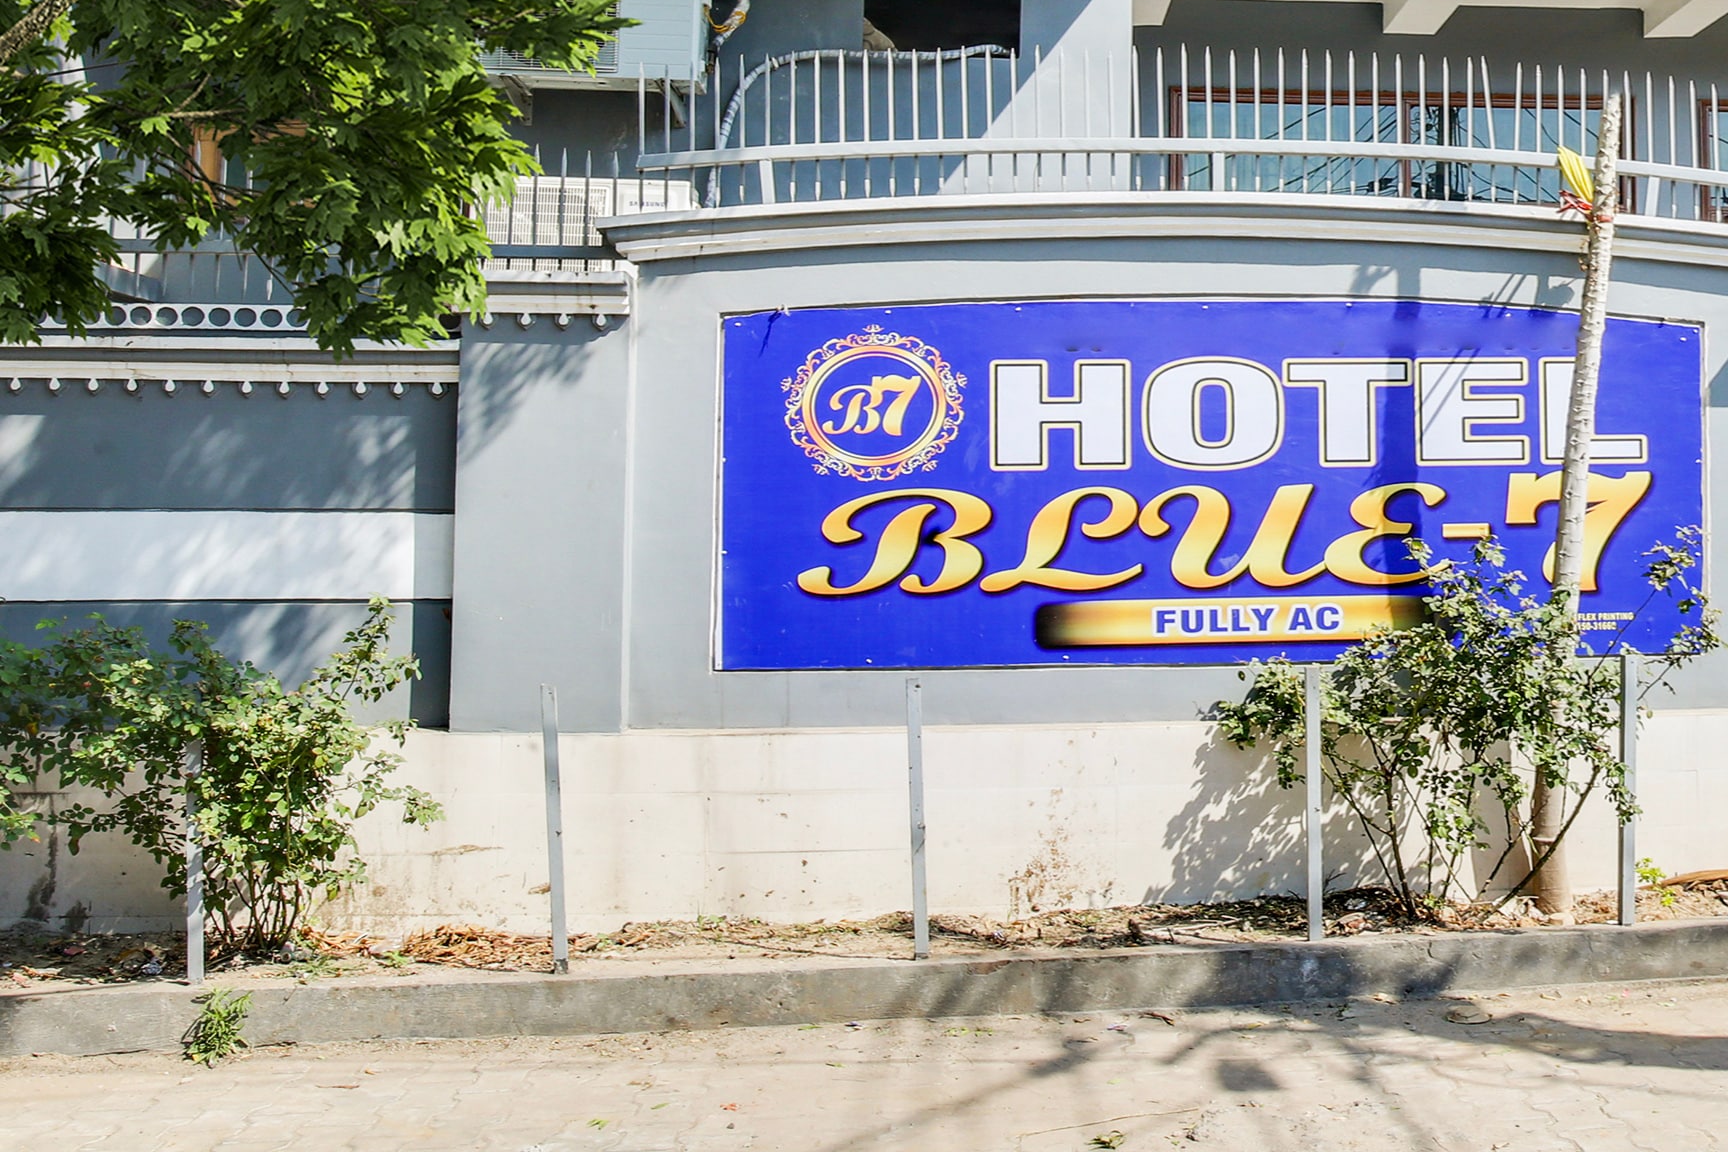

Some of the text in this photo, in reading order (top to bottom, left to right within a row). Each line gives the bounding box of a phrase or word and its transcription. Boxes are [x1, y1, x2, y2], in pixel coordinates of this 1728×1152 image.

[629, 200, 667, 208] SASUNG
[989, 356, 1649, 471] HOTEL
[1154, 605, 1340, 635] FULLY AC
[1598, 612, 1634, 621] PRINTING
